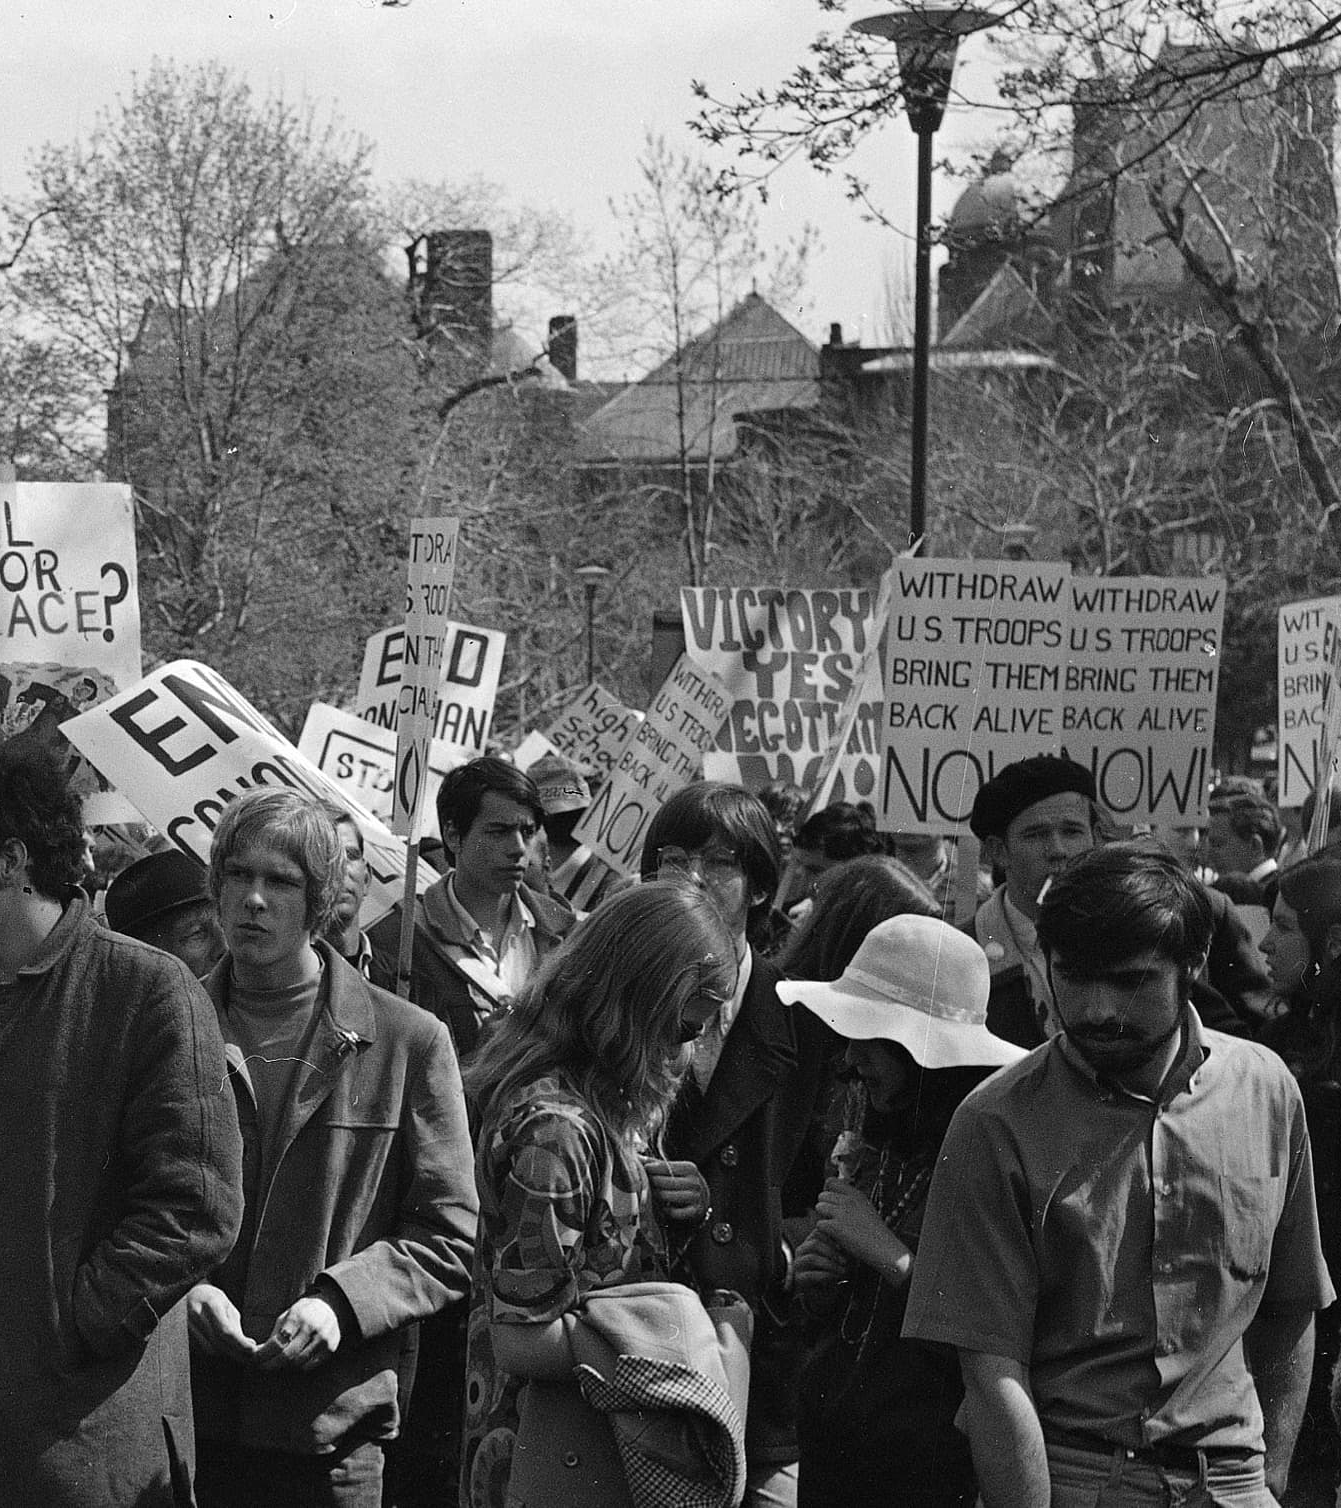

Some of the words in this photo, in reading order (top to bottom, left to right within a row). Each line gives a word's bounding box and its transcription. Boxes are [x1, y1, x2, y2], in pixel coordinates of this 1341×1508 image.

[898, 570, 1064, 602] WITHDRAW
[1072, 587, 1220, 613] WITHDRAW
[681, 586, 870, 653] VICTORY
[953, 617, 1062, 648] TROOPS
[1121, 627, 1217, 652] TROOPS
[742, 651, 853, 700] YES
[892, 658, 972, 688] BRING
[985, 662, 1059, 691] THEM
[1065, 666, 1136, 693] BRING
[1149, 667, 1213, 692] THEM
[889, 701, 960, 731] BACK
[972, 706, 1054, 735] ALIVE
[1062, 706, 1125, 731] BACK
[1137, 707, 1209, 732] ALIVE
